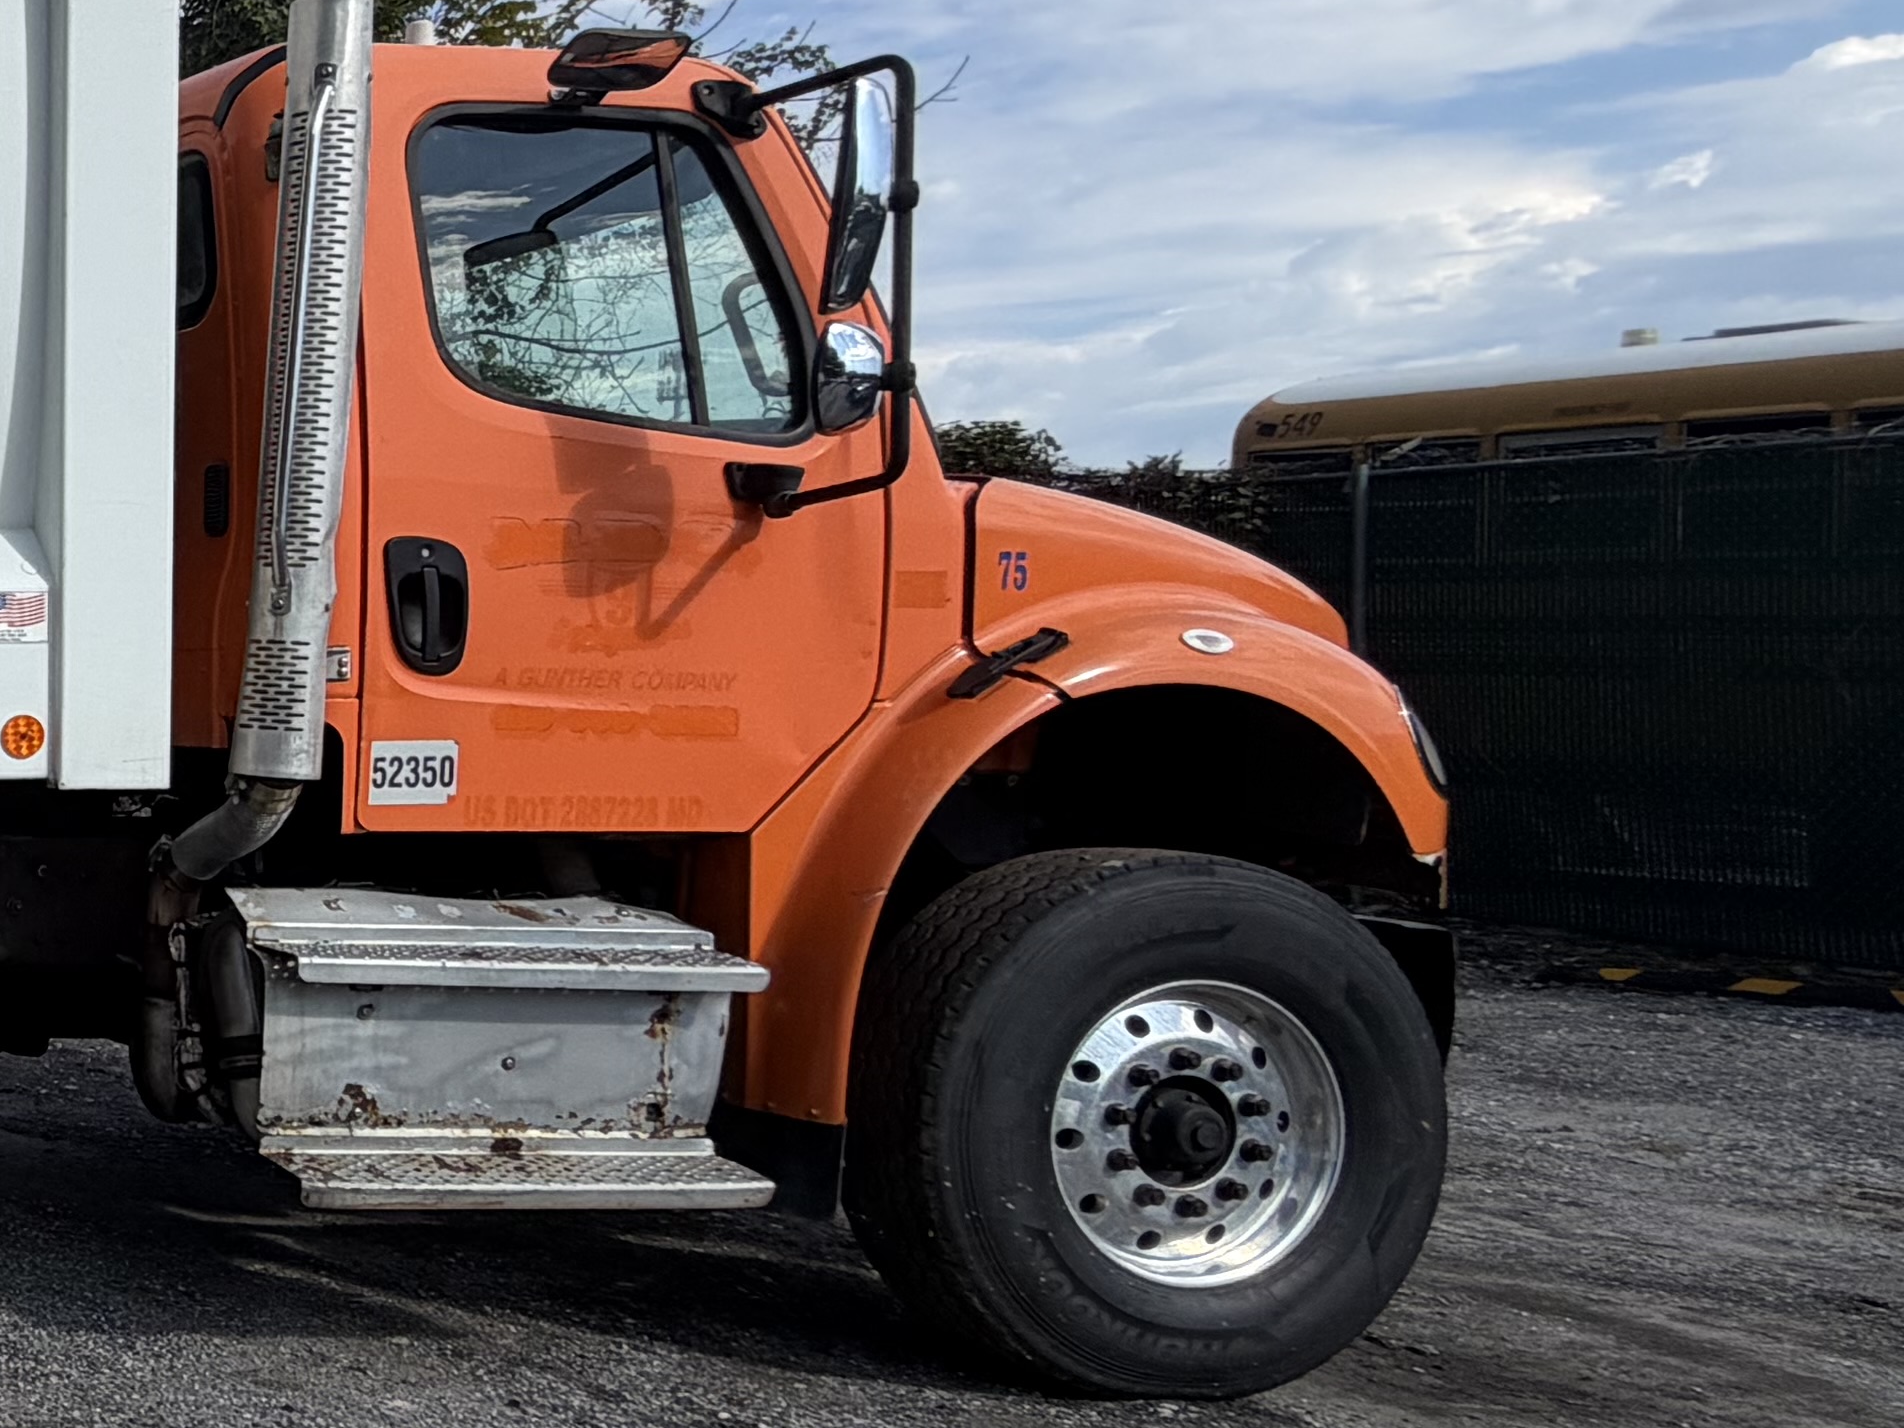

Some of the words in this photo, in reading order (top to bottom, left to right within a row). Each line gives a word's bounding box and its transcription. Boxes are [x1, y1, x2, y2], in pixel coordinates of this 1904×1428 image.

[1278, 411, 1324, 439] 549
[998, 551, 1030, 591] 75
[630, 669, 739, 692] COMPANY
[371, 756, 456, 790] 52350
[463, 795, 497, 827] US
[504, 795, 554, 827] DOT
